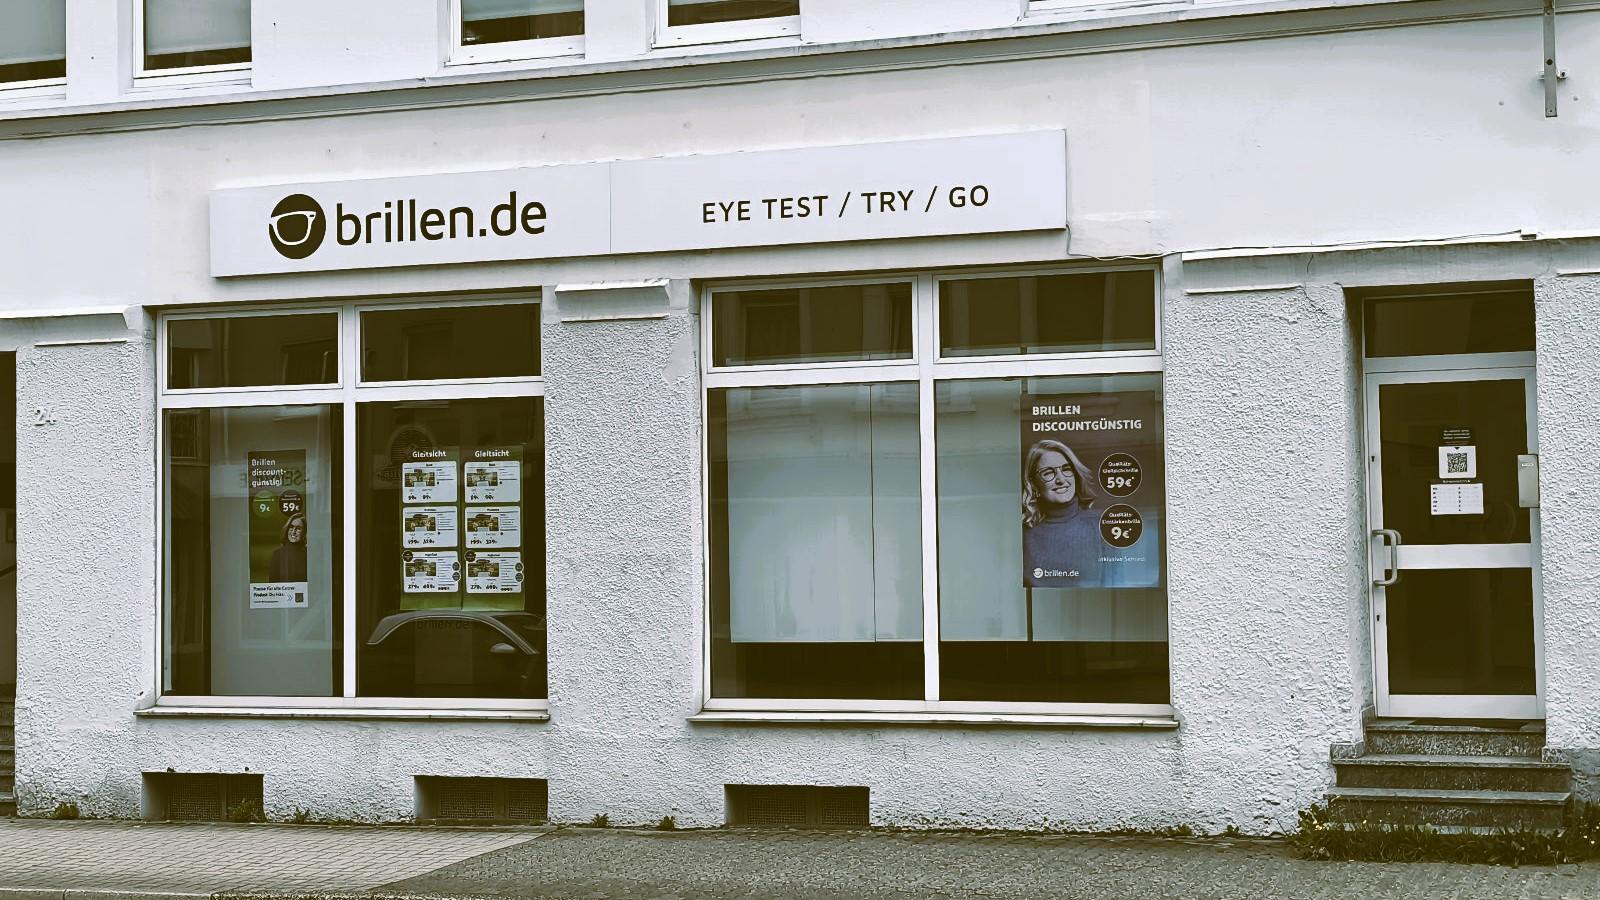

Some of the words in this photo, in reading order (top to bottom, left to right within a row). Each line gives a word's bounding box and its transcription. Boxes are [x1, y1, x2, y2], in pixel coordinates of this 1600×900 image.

[702, 199, 752, 224] EYE
[761, 195, 829, 220] TEST
[838, 191, 852, 218] /
[860, 189, 914, 214] TRY
[924, 185, 938, 213] /
[948, 184, 990, 208] GO
[336, 190, 547, 246] brillen.de
[1031, 404, 1081, 416] BRILLEN
[1031, 417, 1142, 432] DISCOUNTGÜNSTIG
[412, 450, 447, 458] Gleitsicht
[474, 449, 510, 458] Gleitsicht
[251, 458, 276, 466] Brillen
[251, 468, 287, 476] discount-
